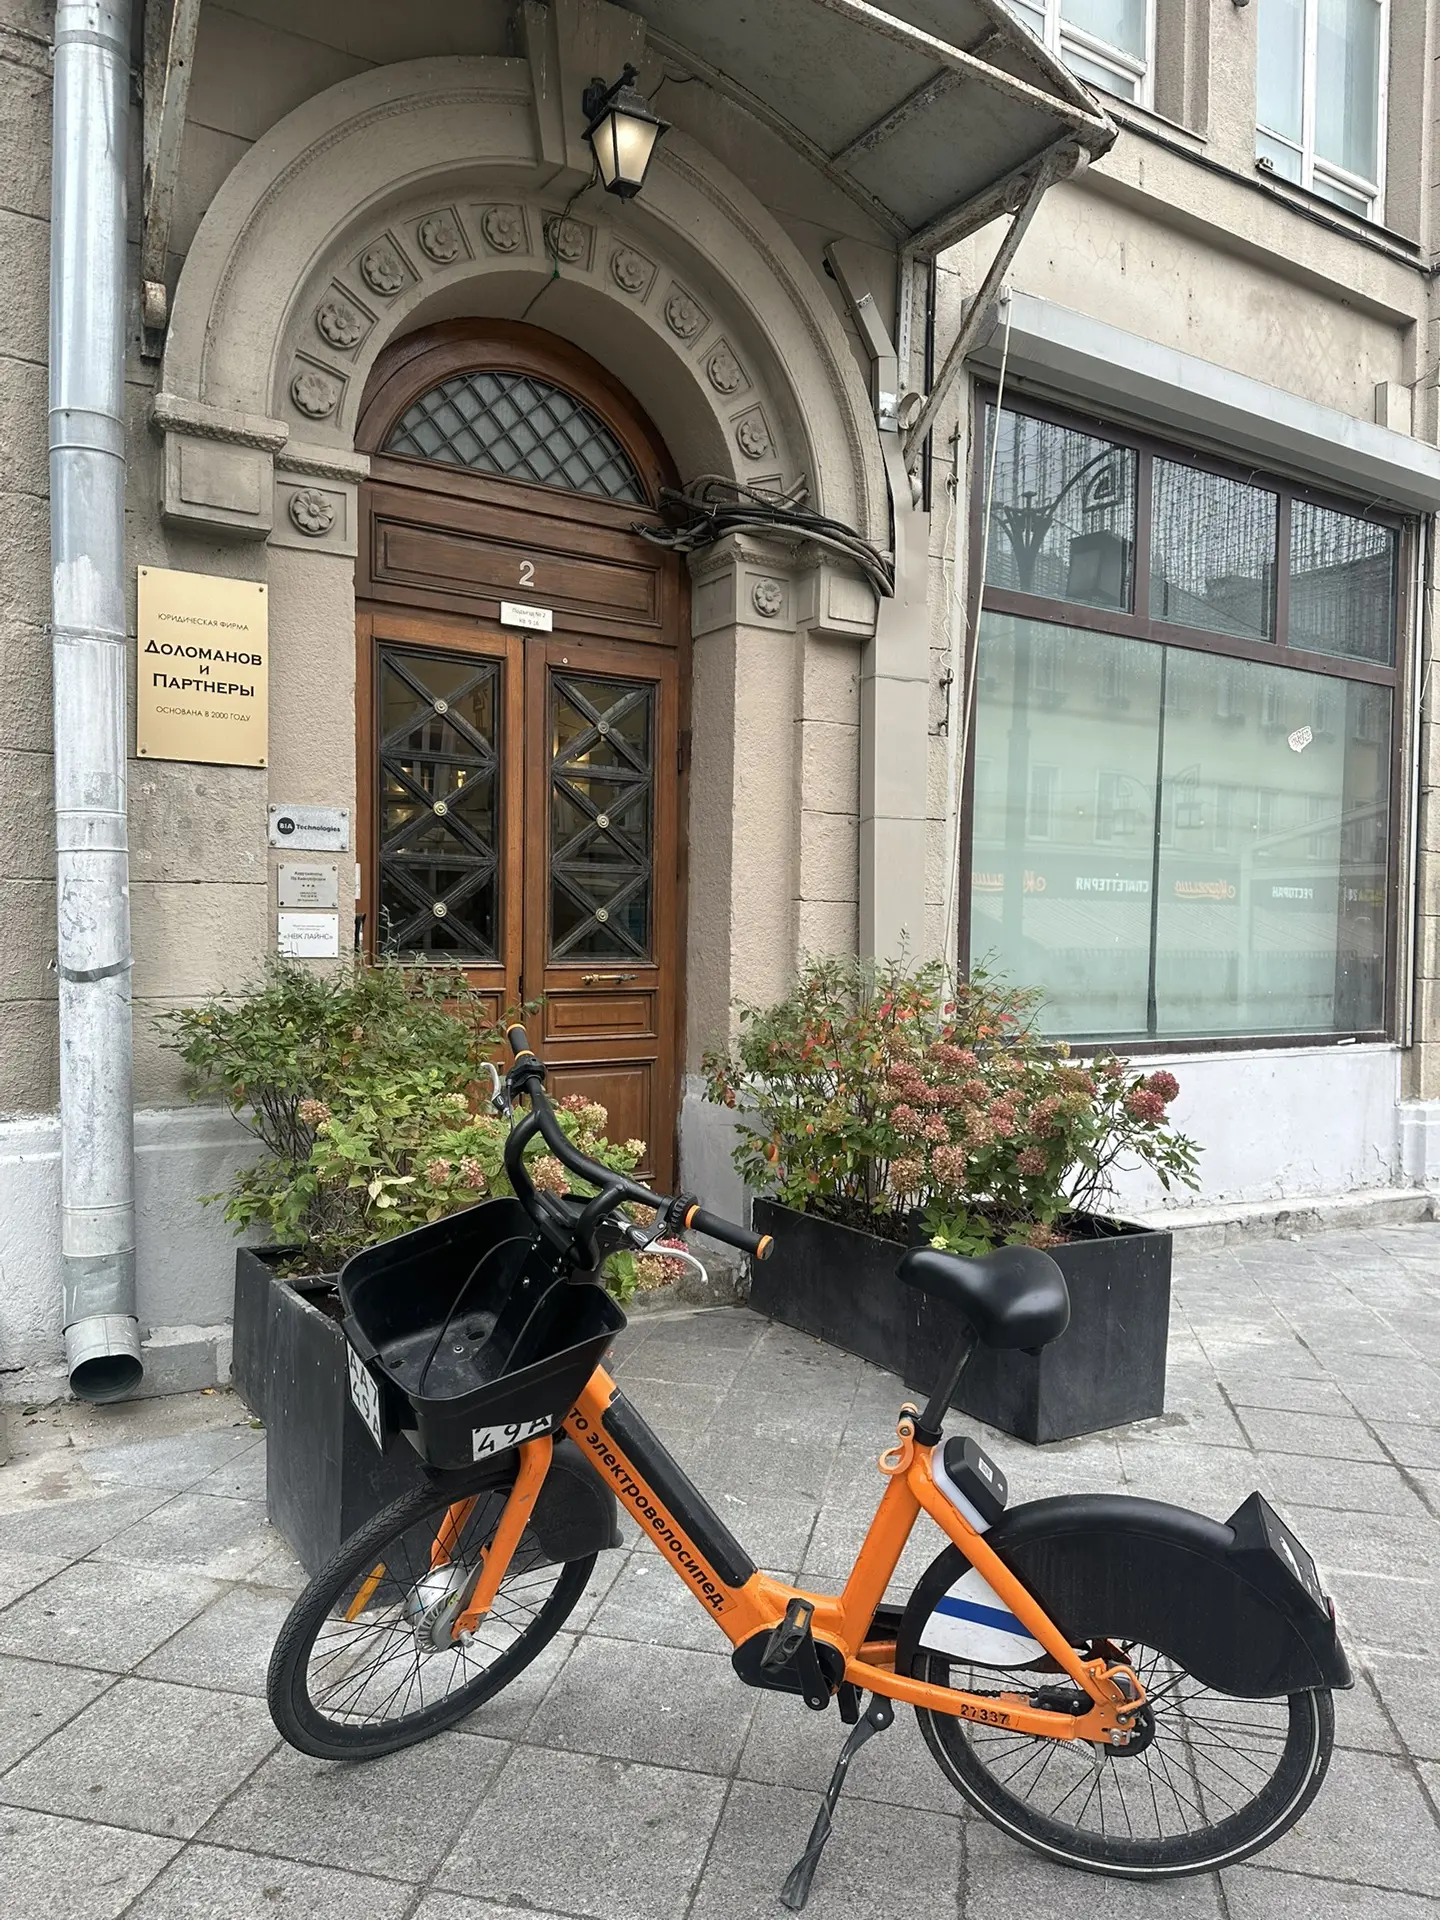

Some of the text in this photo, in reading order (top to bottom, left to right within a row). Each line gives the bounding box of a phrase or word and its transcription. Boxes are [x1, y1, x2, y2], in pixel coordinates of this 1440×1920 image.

[519, 560, 535, 587] 2
[158, 612, 249, 631] ЮРИДИЧЕСКАЯ ФИРМА
[156, 705, 251, 722] ОСНОВАНА В 2000 ГОДУ
[296, 824, 341, 833] Technologies
[586, 1432, 725, 1612] электровелосипед.
[961, 1704, 1009, 1725] 27337
